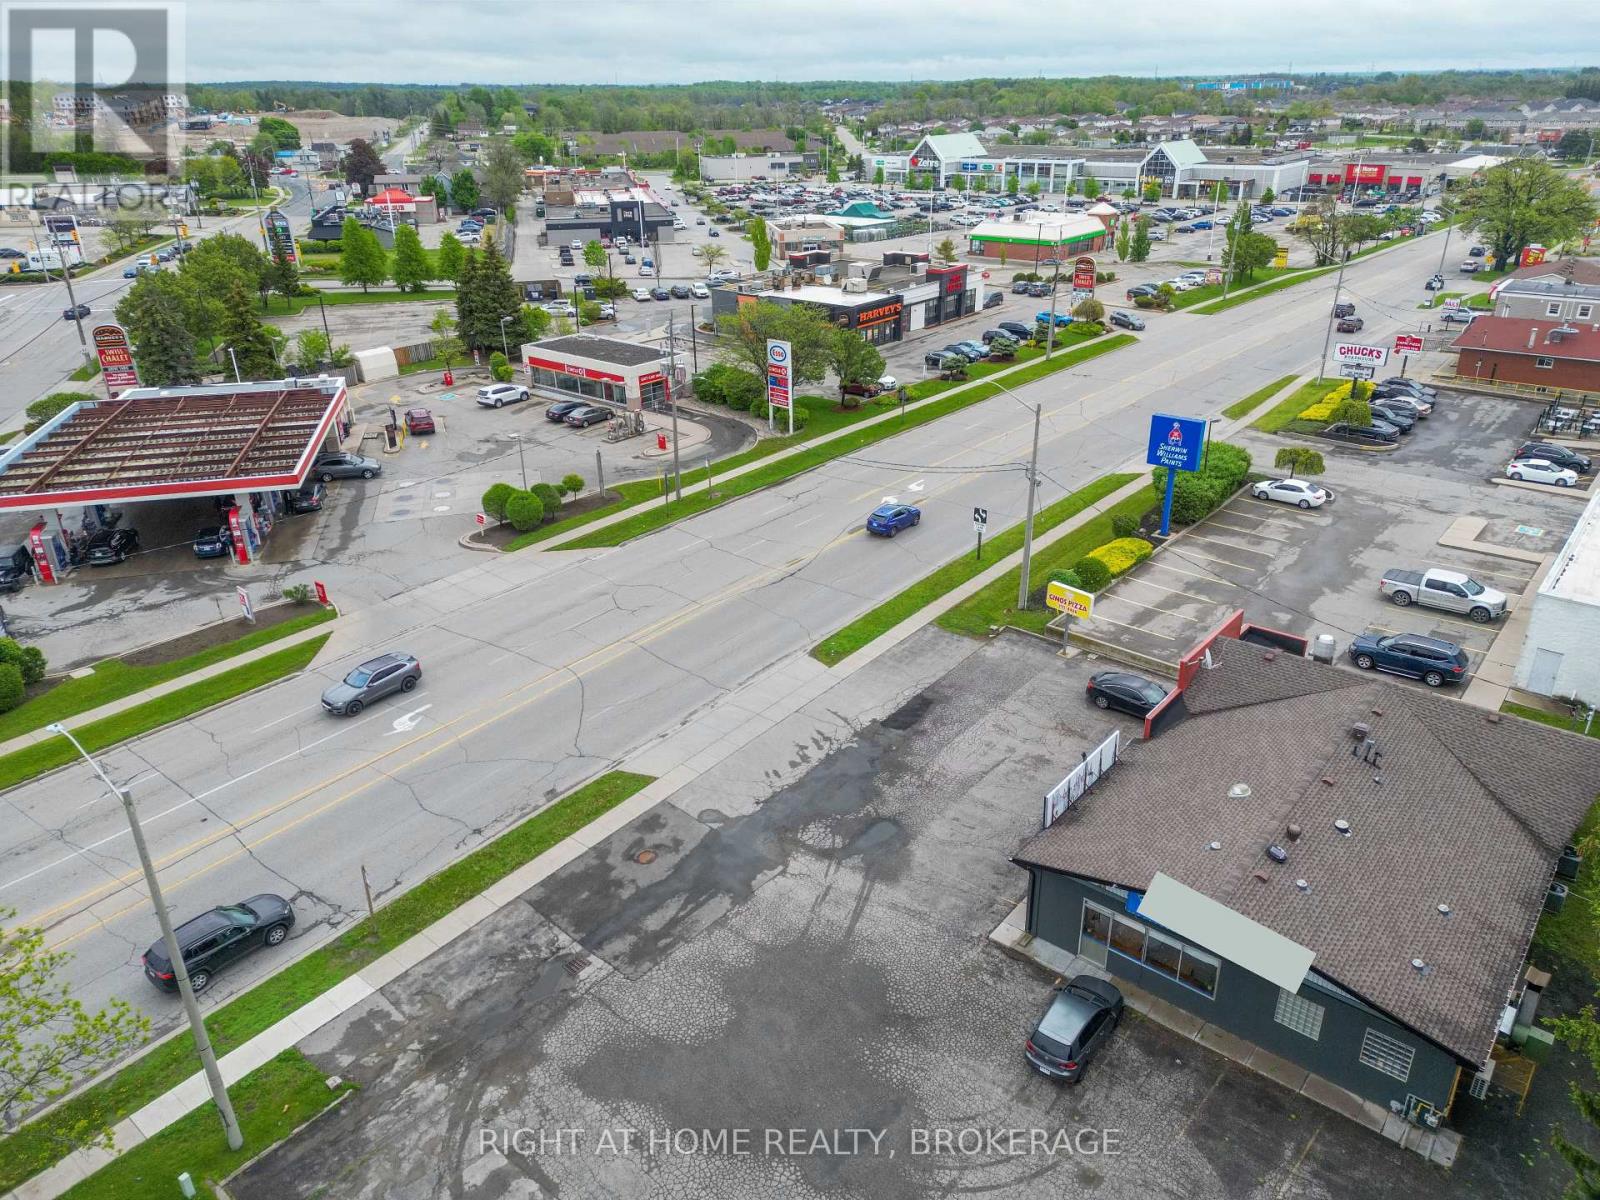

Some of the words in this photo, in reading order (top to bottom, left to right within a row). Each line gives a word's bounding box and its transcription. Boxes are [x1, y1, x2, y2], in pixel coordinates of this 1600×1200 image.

[918, 158, 939, 167] Zehrs
[859, 302, 902, 323] HARVEY'S
[1339, 346, 1383, 359] CHUCK'S
[101, 354, 129, 364] CHALET
[1159, 442, 1188, 454] SHERWIN
[1156, 450, 1188, 461] WILLIAMS
[1160, 457, 1182, 467] PAINTS
[1068, 600, 1087, 612] PIZZA
